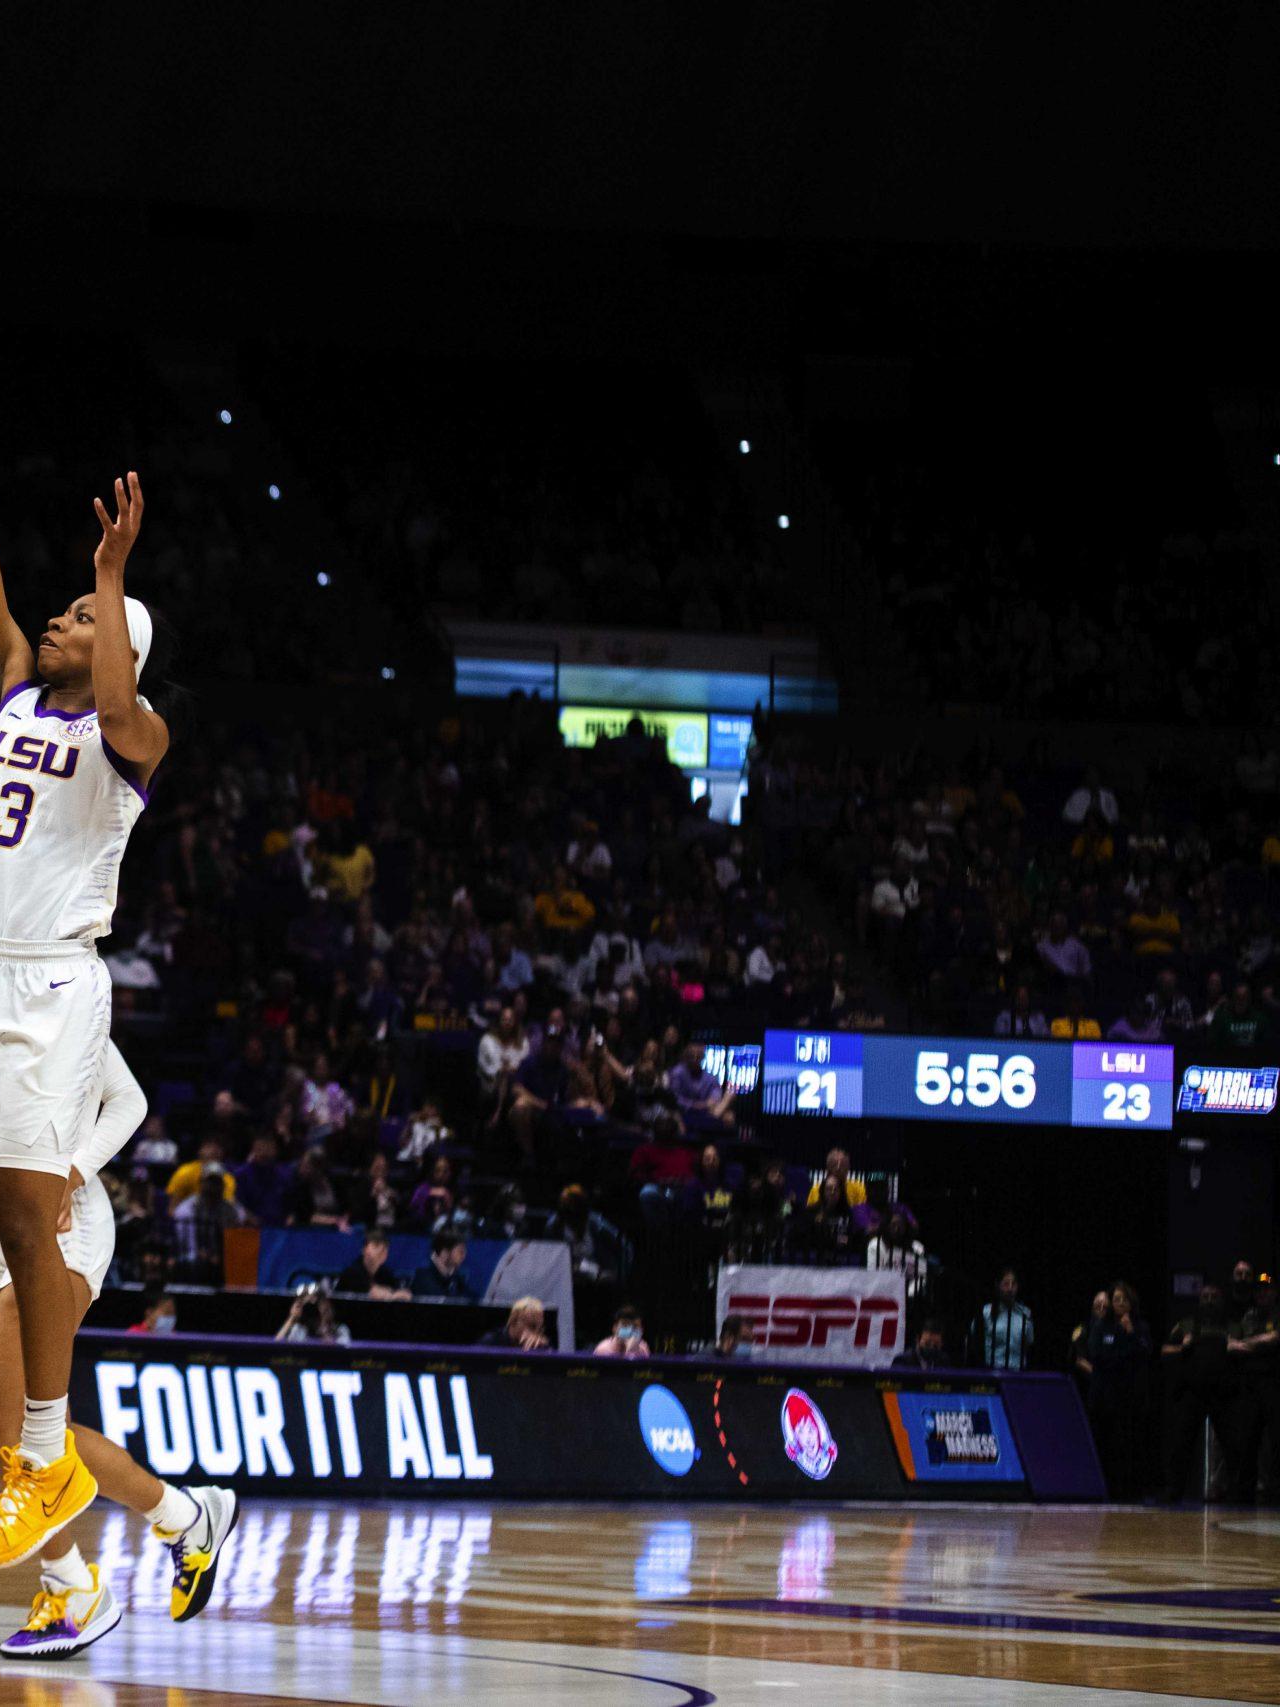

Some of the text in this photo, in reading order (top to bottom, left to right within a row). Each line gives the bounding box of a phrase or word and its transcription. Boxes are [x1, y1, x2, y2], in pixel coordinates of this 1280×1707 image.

[915, 1051, 1037, 1108] 5:56
[1101, 1052, 1146, 1073] LSU
[797, 1069, 837, 1110] 21
[1103, 1082, 1151, 1122] 23
[728, 1295, 899, 1348] ESPN
[95, 1361, 494, 1480] FOUR IT ALL
[650, 1427, 695, 1453] NCAA
